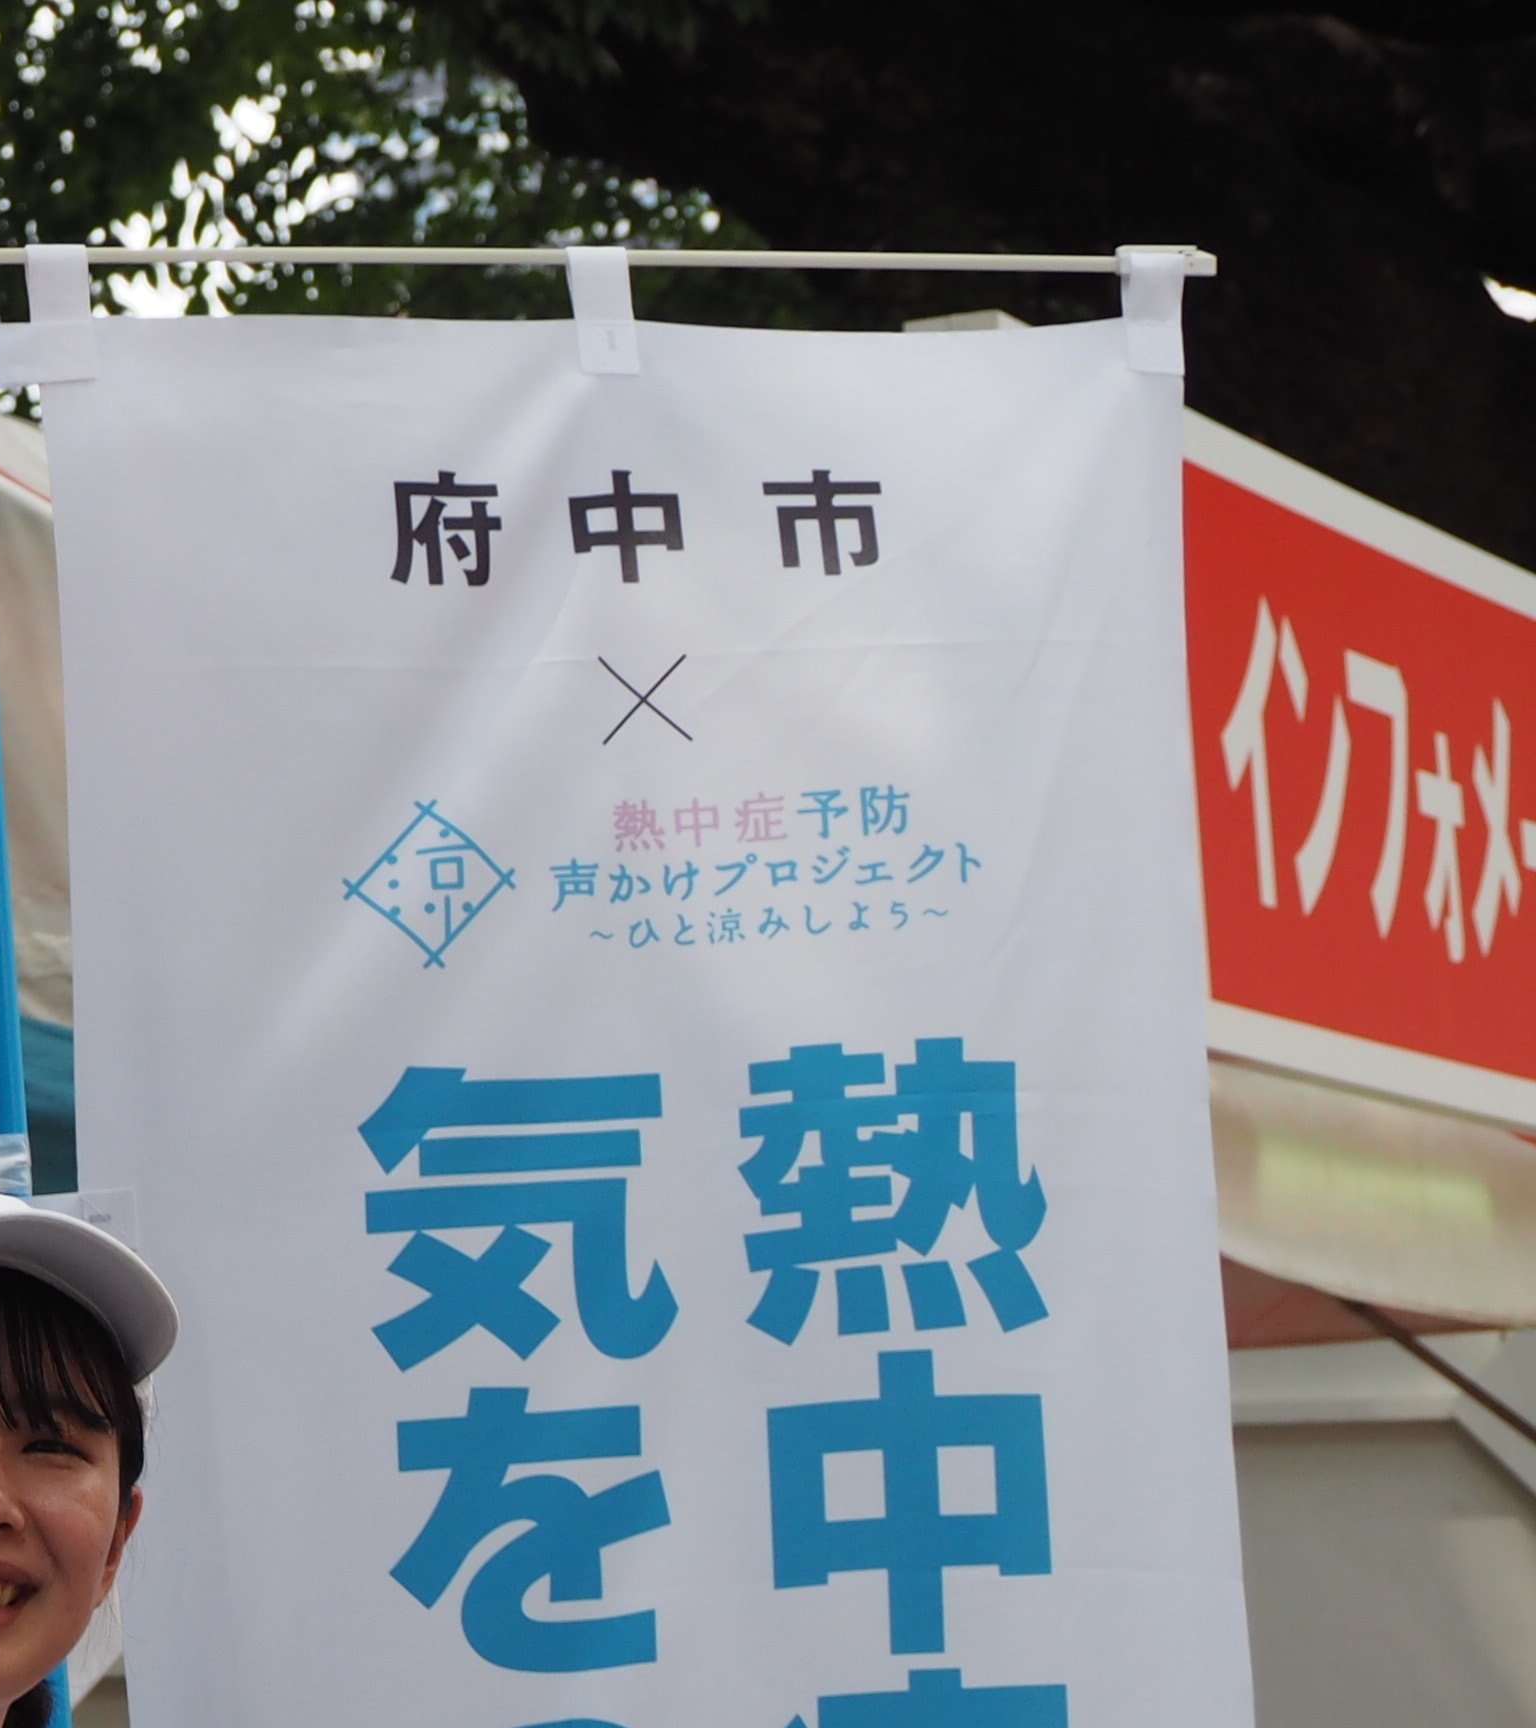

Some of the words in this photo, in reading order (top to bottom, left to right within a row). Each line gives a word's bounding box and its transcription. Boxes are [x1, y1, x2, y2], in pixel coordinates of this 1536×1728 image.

[389, 468, 885, 588] 府中市
[612, 784, 911, 852] 熱中症予防
[1221, 594, 1536, 963] インフォメ
[548, 841, 984, 912] 声かけプロジェクト
